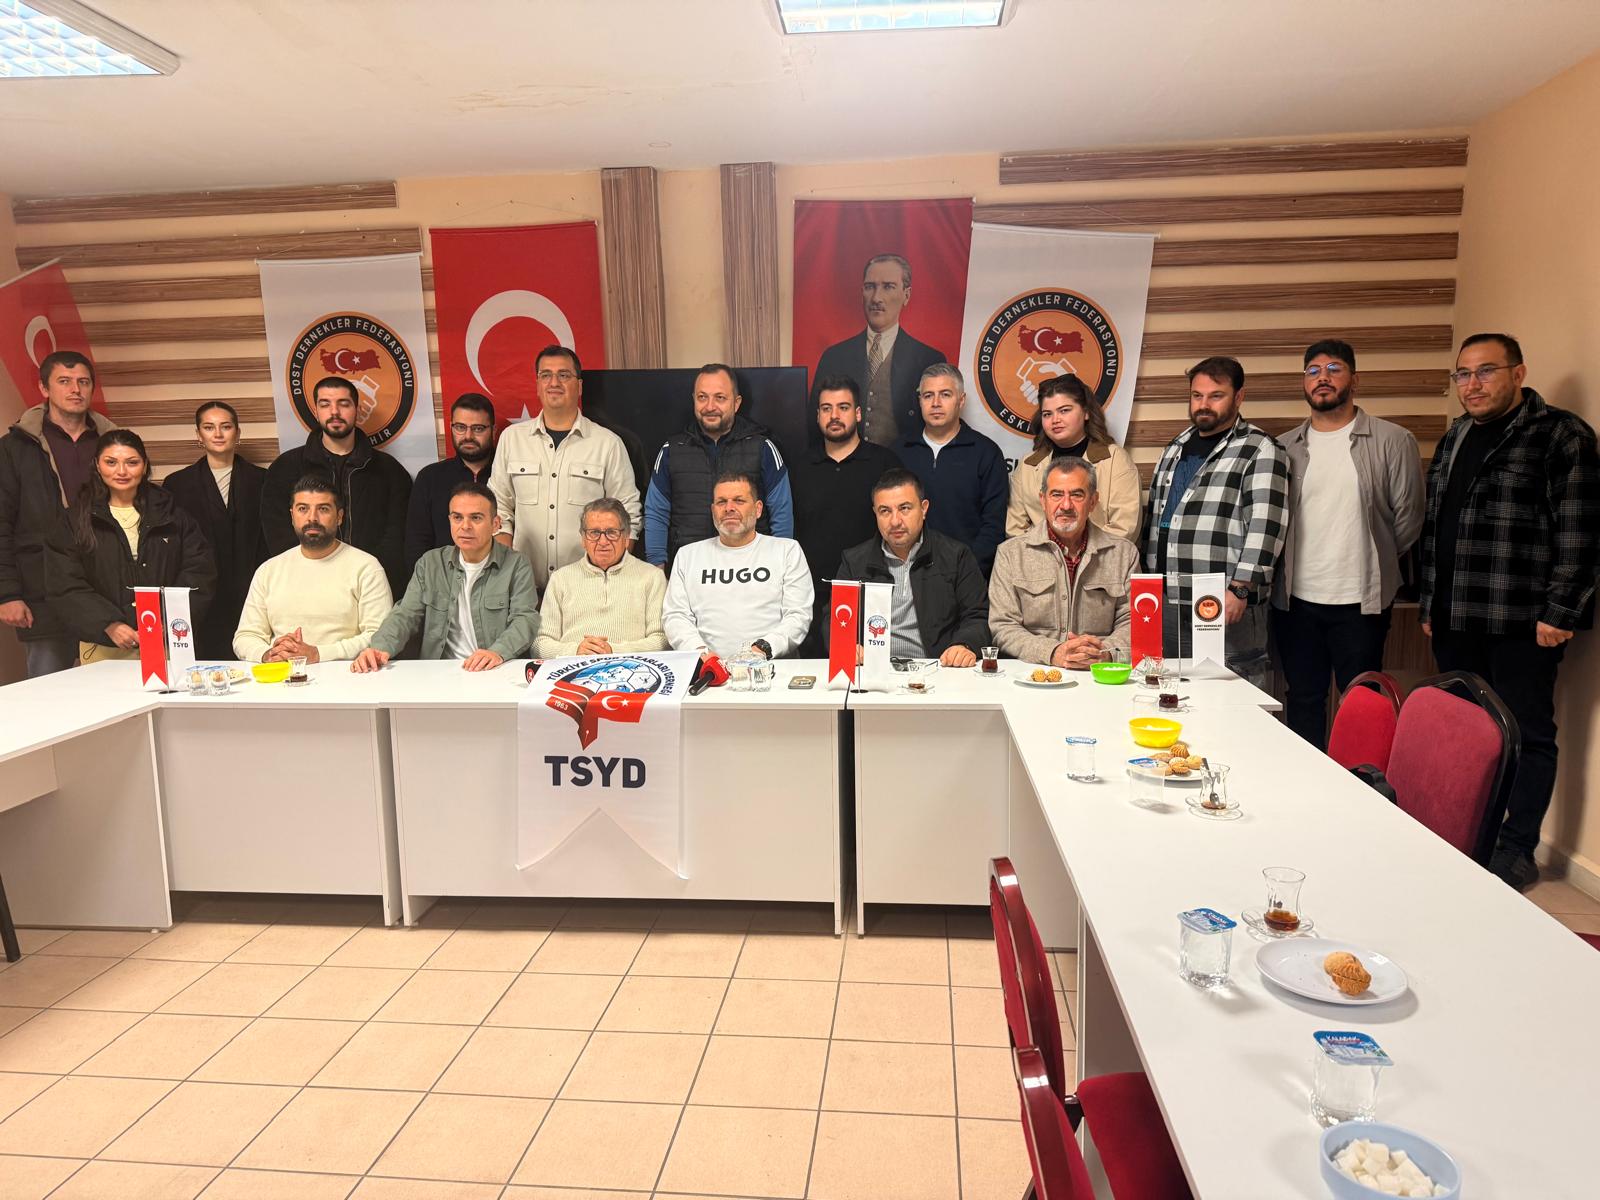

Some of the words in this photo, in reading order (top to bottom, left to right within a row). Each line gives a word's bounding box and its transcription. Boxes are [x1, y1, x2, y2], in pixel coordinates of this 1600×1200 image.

[296, 318, 350, 360] DERNEKLER
[980, 337, 995, 372] DOST
[993, 294, 1061, 335] DERNEKLER
[1065, 297, 1118, 376] FEDERASYONU
[355, 319, 413, 388] FEDERASYONU
[291, 363, 302, 395] DOST
[999, 408, 1031, 432] ESKİ
[369, 428, 392, 445] HİR
[701, 567, 771, 584] HUGO
[867, 639, 886, 647] TSYD
[547, 661, 589, 681] TÜRKİYE
[658, 670, 676, 696] DERNEĞİ
[554, 699, 569, 711] 1963
[544, 755, 646, 788] TSYD
